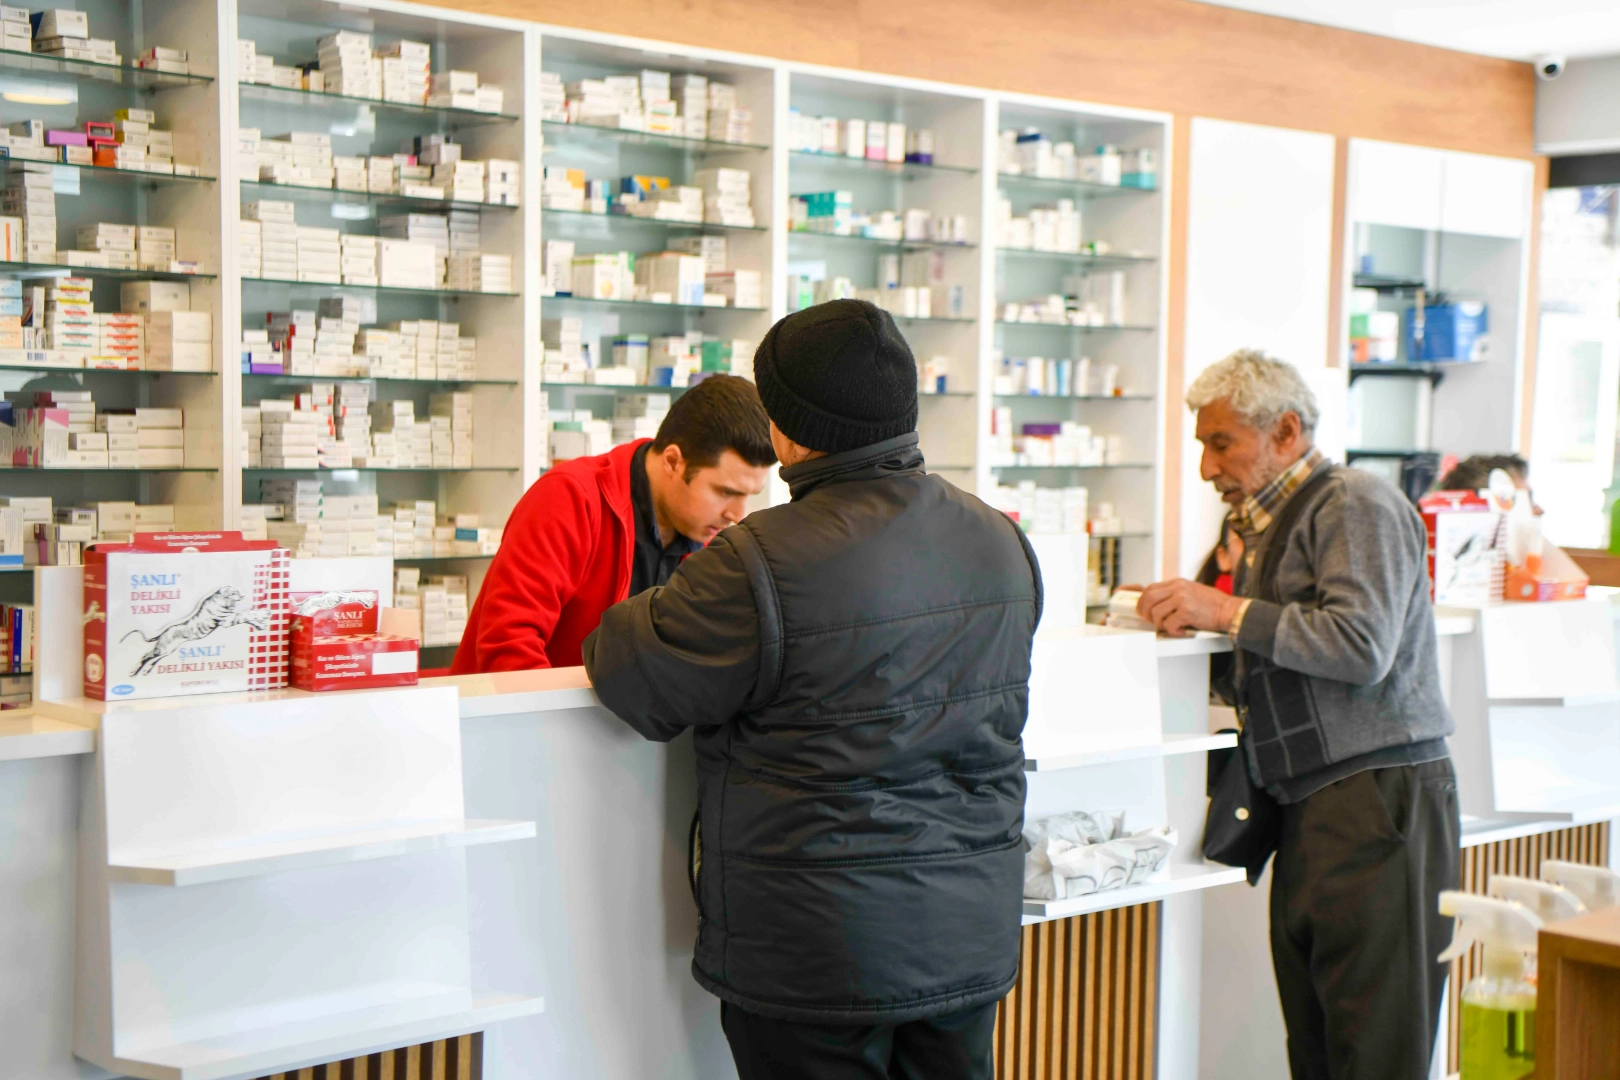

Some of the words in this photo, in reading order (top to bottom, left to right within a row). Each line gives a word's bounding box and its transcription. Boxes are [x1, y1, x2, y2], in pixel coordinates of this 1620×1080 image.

[130, 574, 176, 590] ŞANLI
[130, 589, 181, 601] DELİKLİ
[130, 604, 170, 614] YAKISI
[334, 610, 363, 622] ŞANLI
[179, 646, 221, 661] ŞANLI
[158, 661, 205, 674] DELİKLİ
[207, 660, 244, 670] YAKISI
